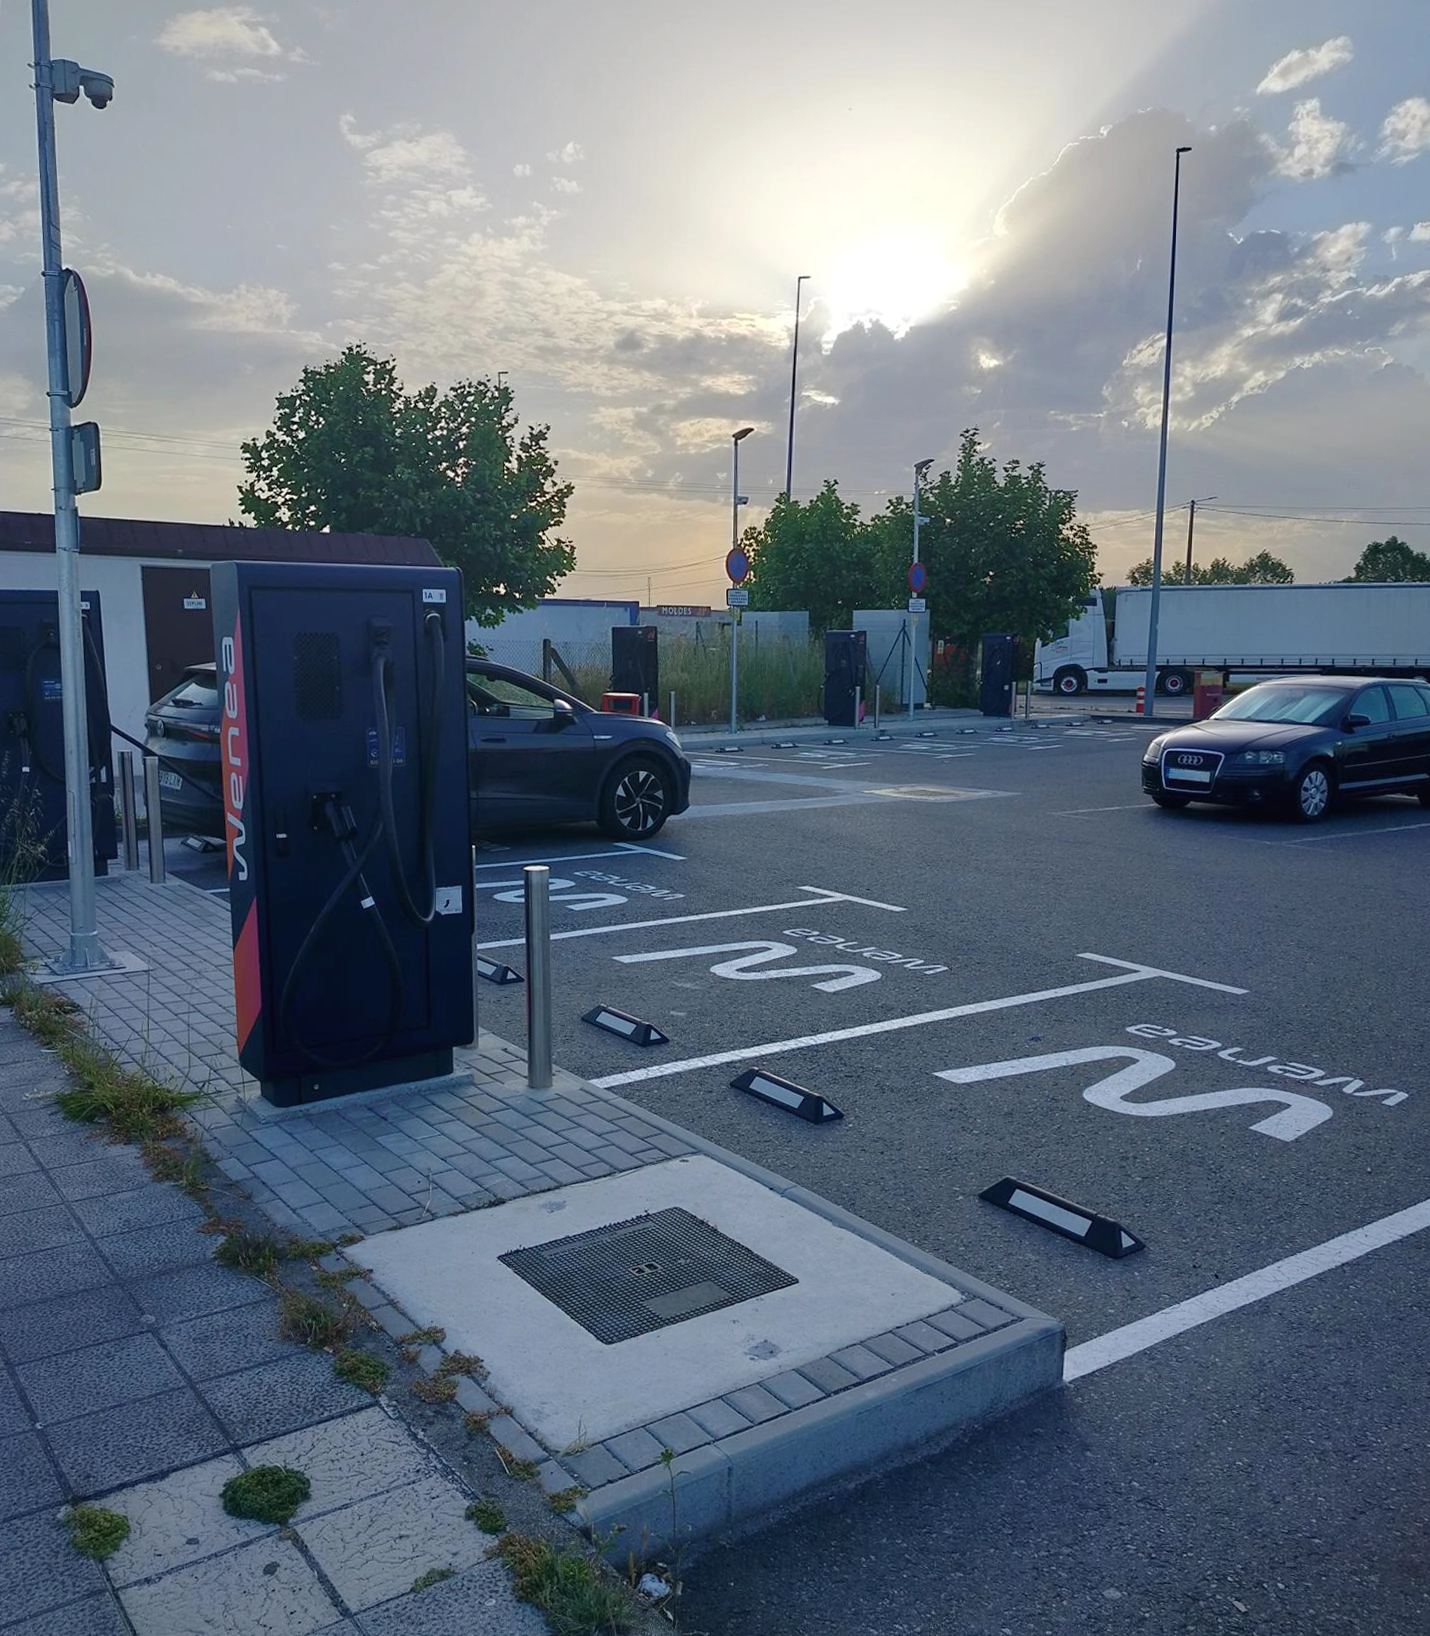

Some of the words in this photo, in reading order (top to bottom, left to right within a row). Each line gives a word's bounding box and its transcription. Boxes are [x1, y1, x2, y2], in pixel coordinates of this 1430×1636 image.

[661, 606, 692, 616] MOLDES
[221, 636, 248, 881] wenea
[573, 870, 686, 901] wenea
[782, 928, 950, 975] wenea
[1125, 1023, 1409, 1107] wenea
